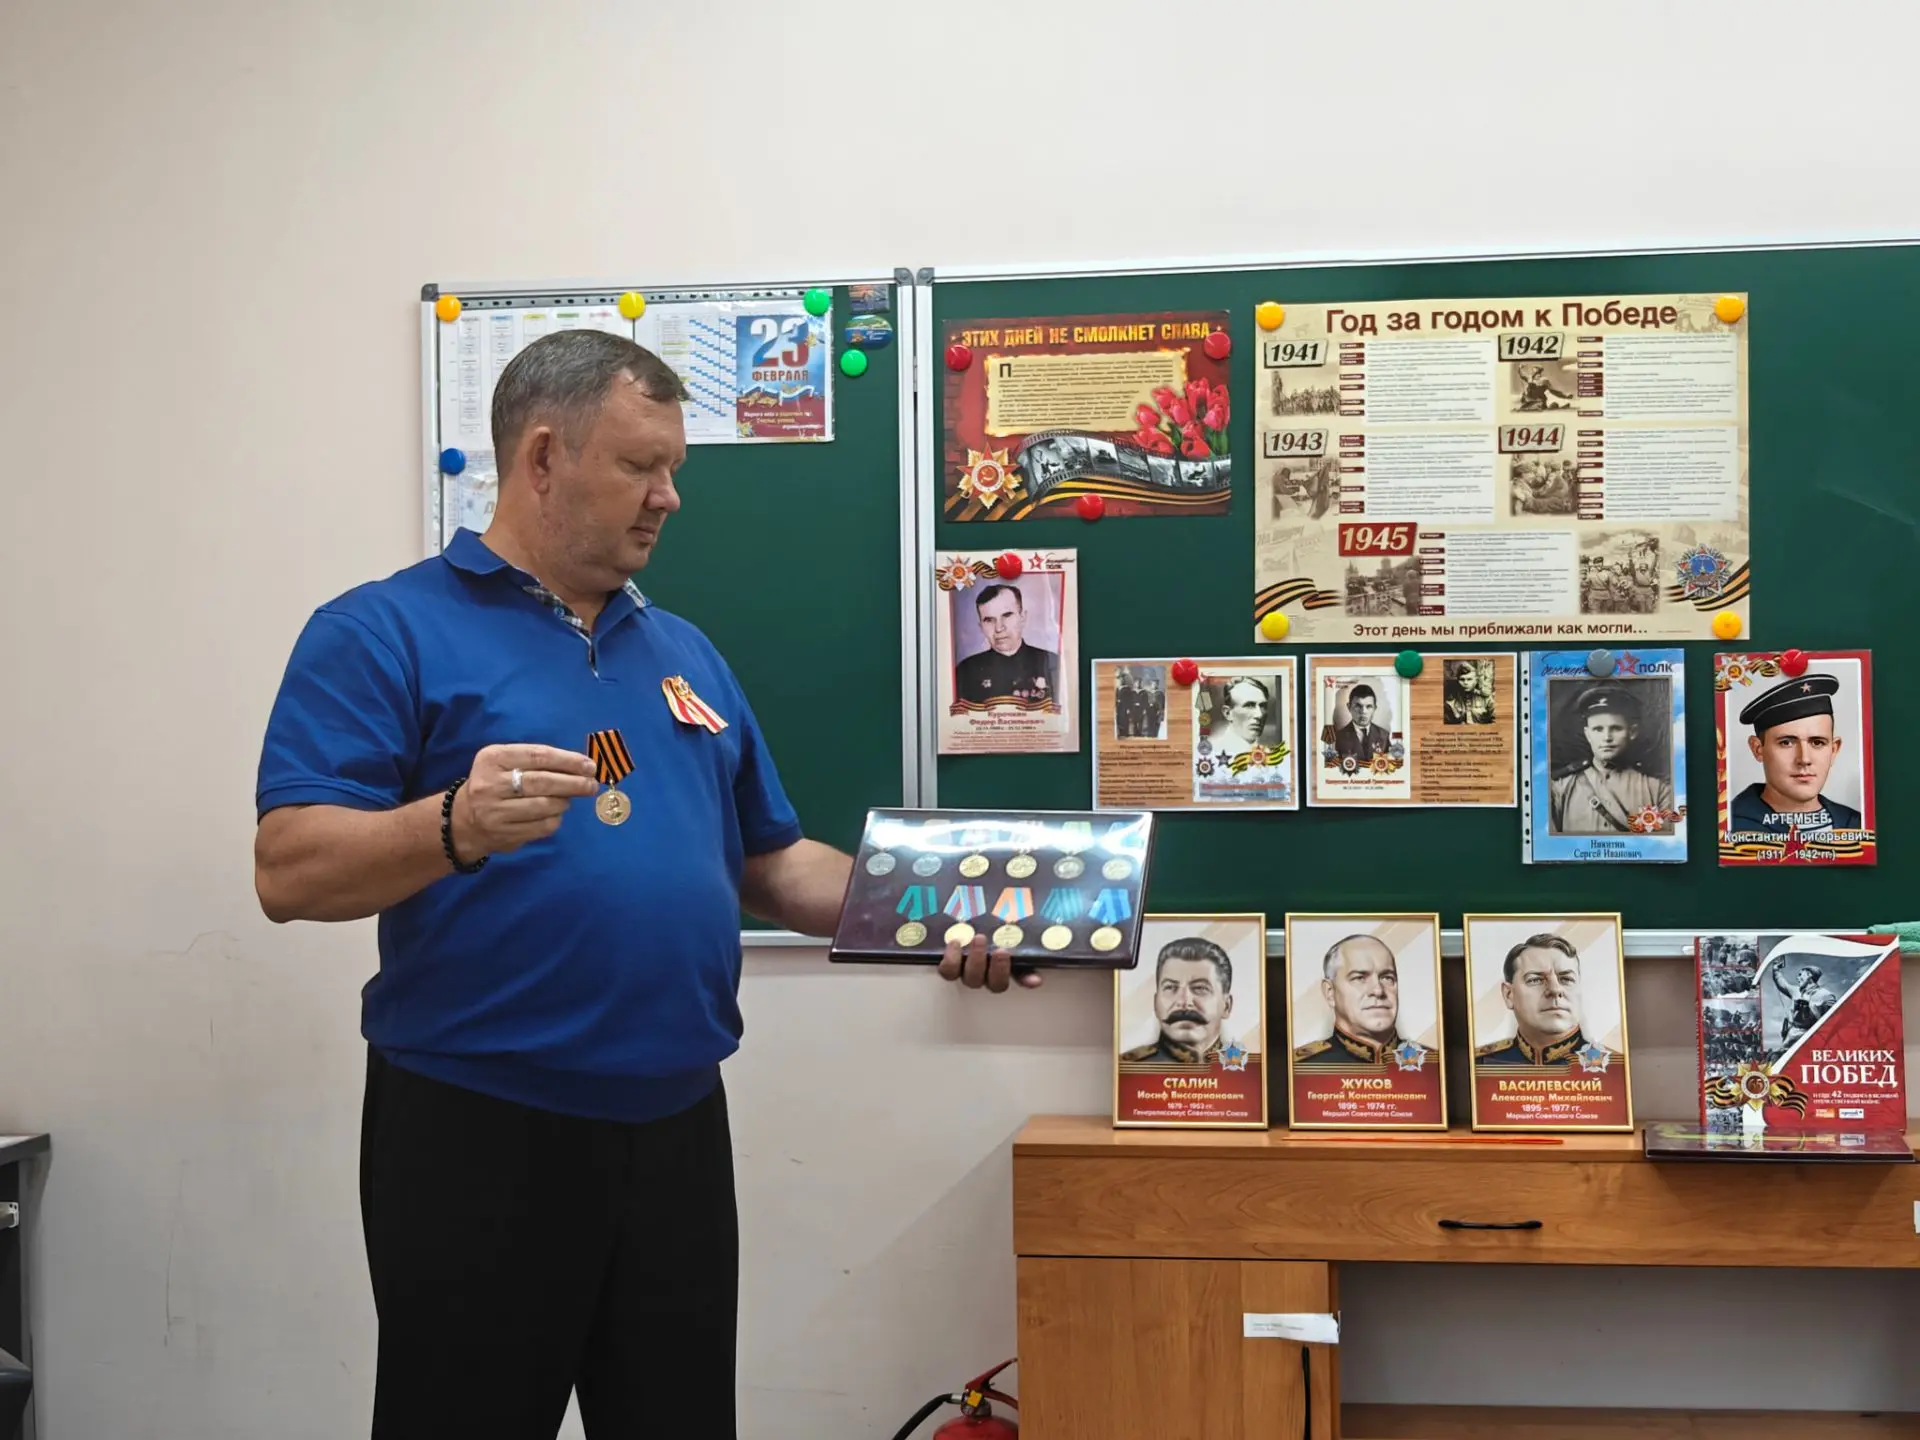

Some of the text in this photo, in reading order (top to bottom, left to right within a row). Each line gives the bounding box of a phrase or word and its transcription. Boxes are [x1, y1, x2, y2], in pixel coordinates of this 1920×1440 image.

[1327, 300, 1678, 336] Год за годом к Победе
[751, 318, 809, 367] 23
[962, 330, 999, 347] ЭТИХ
[1004, 326, 1044, 347] ДНЕЙ
[1049, 328, 1068, 344] НЕ
[1073, 325, 1156, 343] СМОЛКНЕТ
[1506, 336, 1559, 355] 1942
[1271, 343, 1319, 362] 1941
[752, 370, 809, 382] ФЕВРАЛЯ
[1271, 432, 1323, 451] 1943
[1506, 427, 1559, 446] 1944
[1342, 526, 1409, 551] 1945
[1353, 624, 1388, 636] Этот
[1391, 625, 1426, 637] день
[1431, 626, 1455, 635] мы
[1459, 622, 1552, 638] приближали
[1557, 623, 1583, 634] как
[1587, 623, 1648, 635] могли...
[1763, 812, 1828, 825] АРТЕМЬЕВ
[1725, 830, 1869, 843] Константин Григорьевич
[1574, 849, 1601, 860] Сергей
[1757, 849, 1783, 861] (1911
[1795, 850, 1817, 860] 1942
[1812, 1049, 1895, 1062] ВЕЛИКИХ
[1801, 1064, 1898, 1088] ПОБЕД
[1163, 1078, 1218, 1089] СТАЛИН
[1341, 1079, 1392, 1089] ЖУКОВ
[1499, 1078, 1602, 1091] ВАСИЛЕВСКИЙ
[1137, 1091, 1168, 1101] Иосиф
[1308, 1091, 1426, 1101] Георгий Константинович
[1491, 1093, 1612, 1102] Александр Михайлович
[1831, 1090, 1842, 1098] 42
